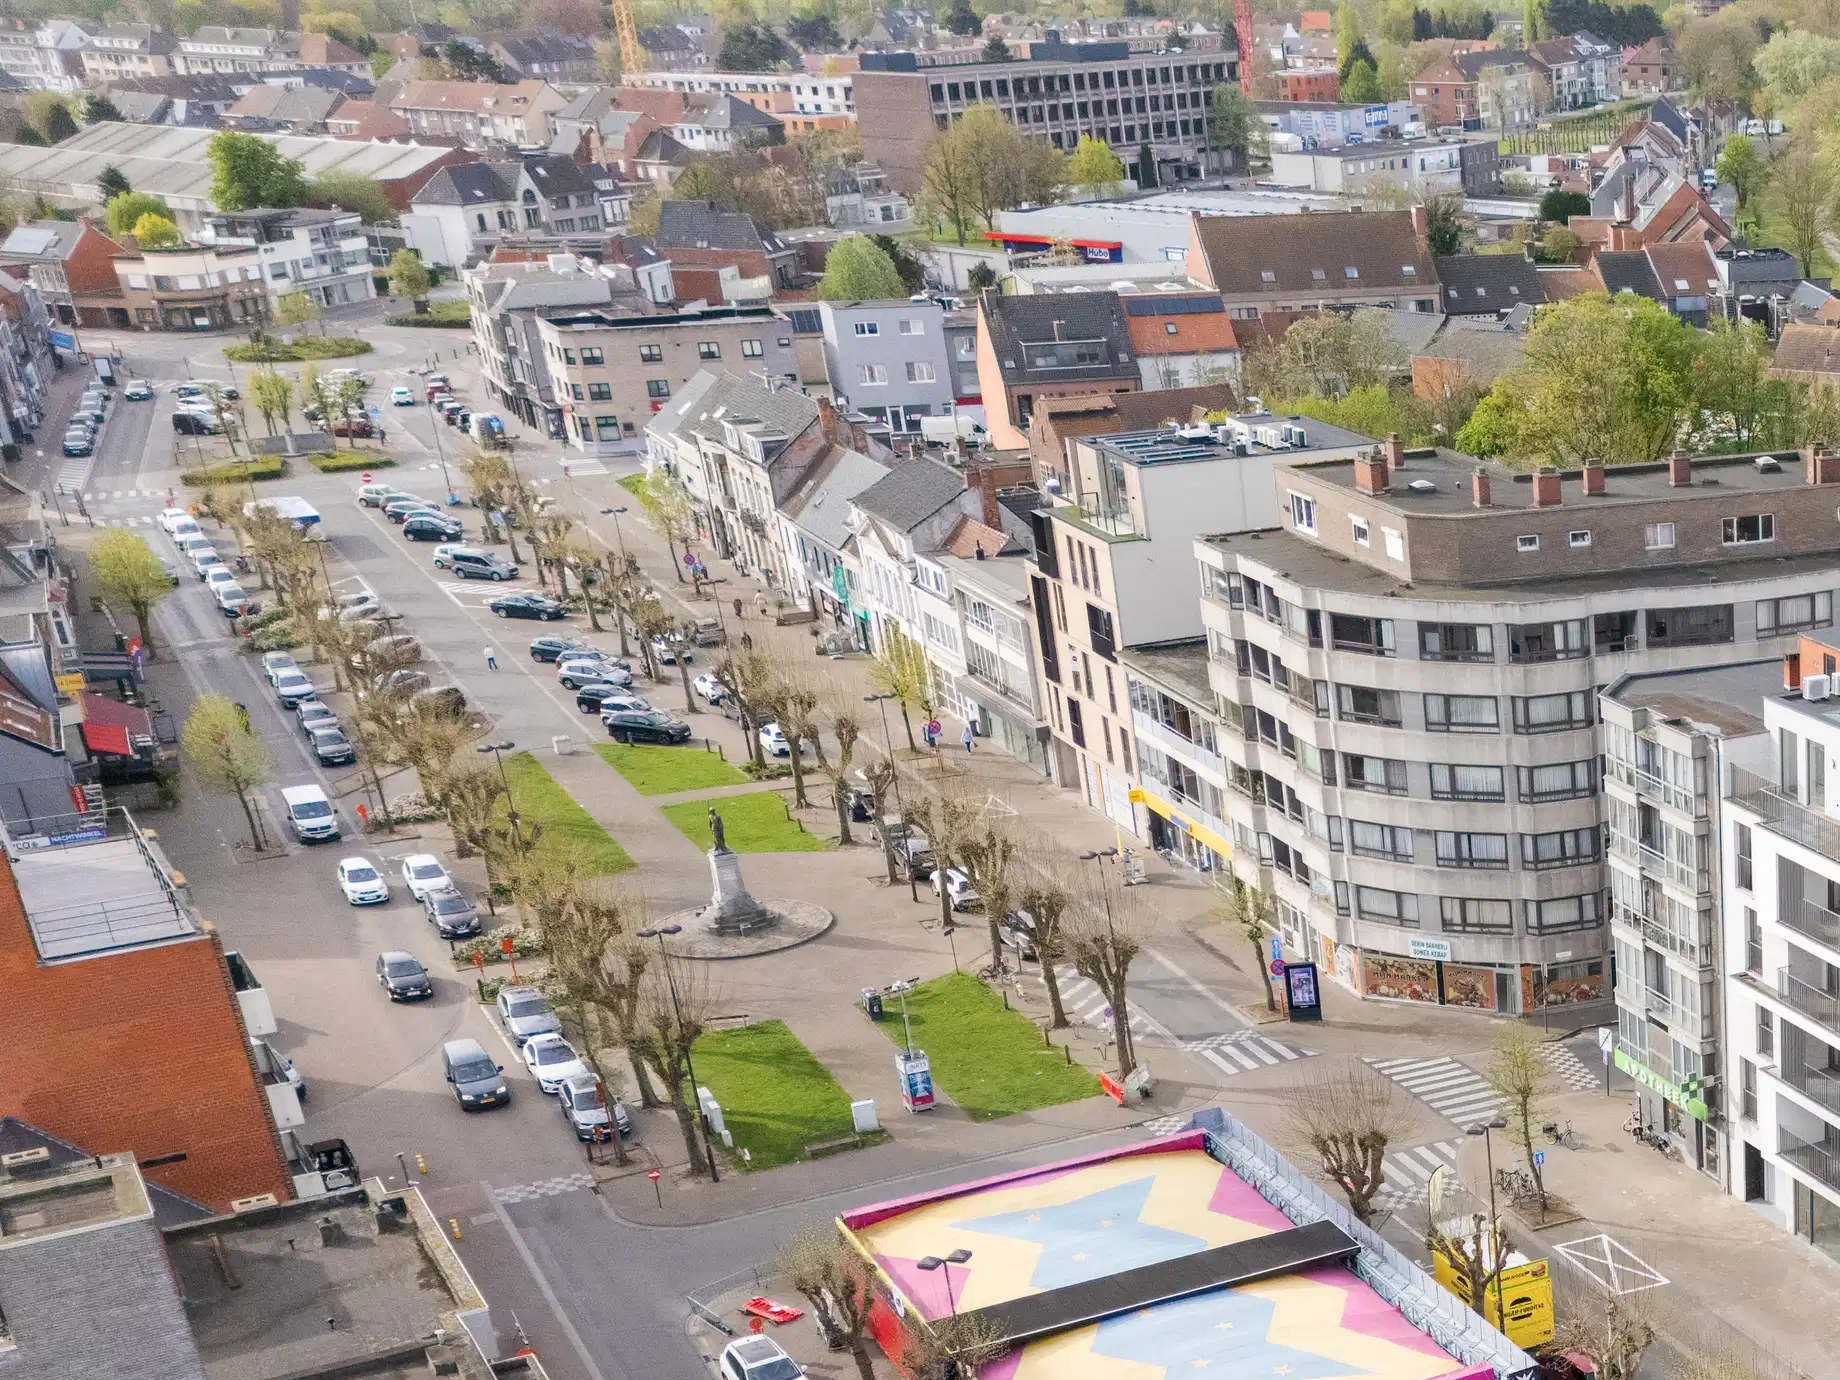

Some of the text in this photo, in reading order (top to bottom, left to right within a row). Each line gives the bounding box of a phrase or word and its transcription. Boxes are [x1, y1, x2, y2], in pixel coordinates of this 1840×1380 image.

[1088, 249, 1109, 258] Hubo
[51, 830, 103, 843] NACHTWINKEL
[1624, 1060, 1689, 1112] APOTHEEK
